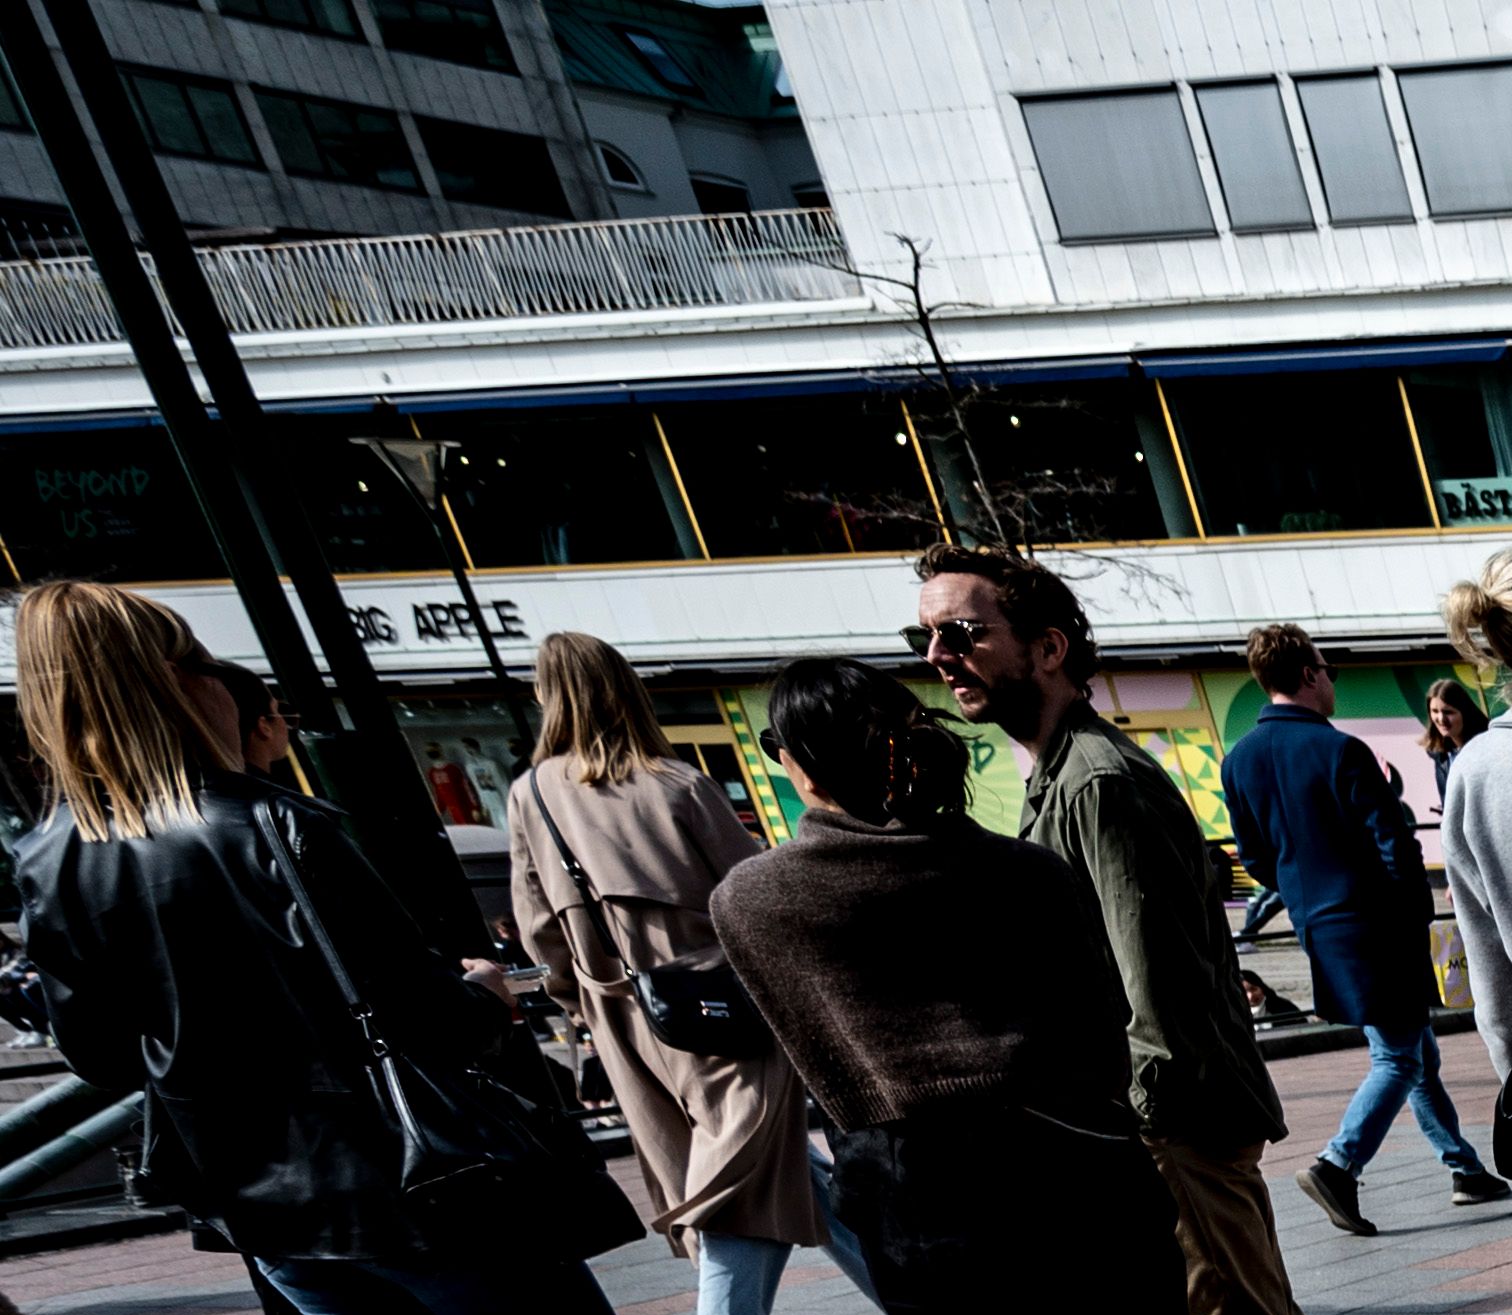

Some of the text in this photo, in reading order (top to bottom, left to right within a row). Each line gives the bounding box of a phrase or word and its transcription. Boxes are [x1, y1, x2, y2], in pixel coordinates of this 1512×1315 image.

[34, 463, 151, 504] BEYOND
[60, 509, 99, 540] US
[411, 600, 531, 643] APPE
